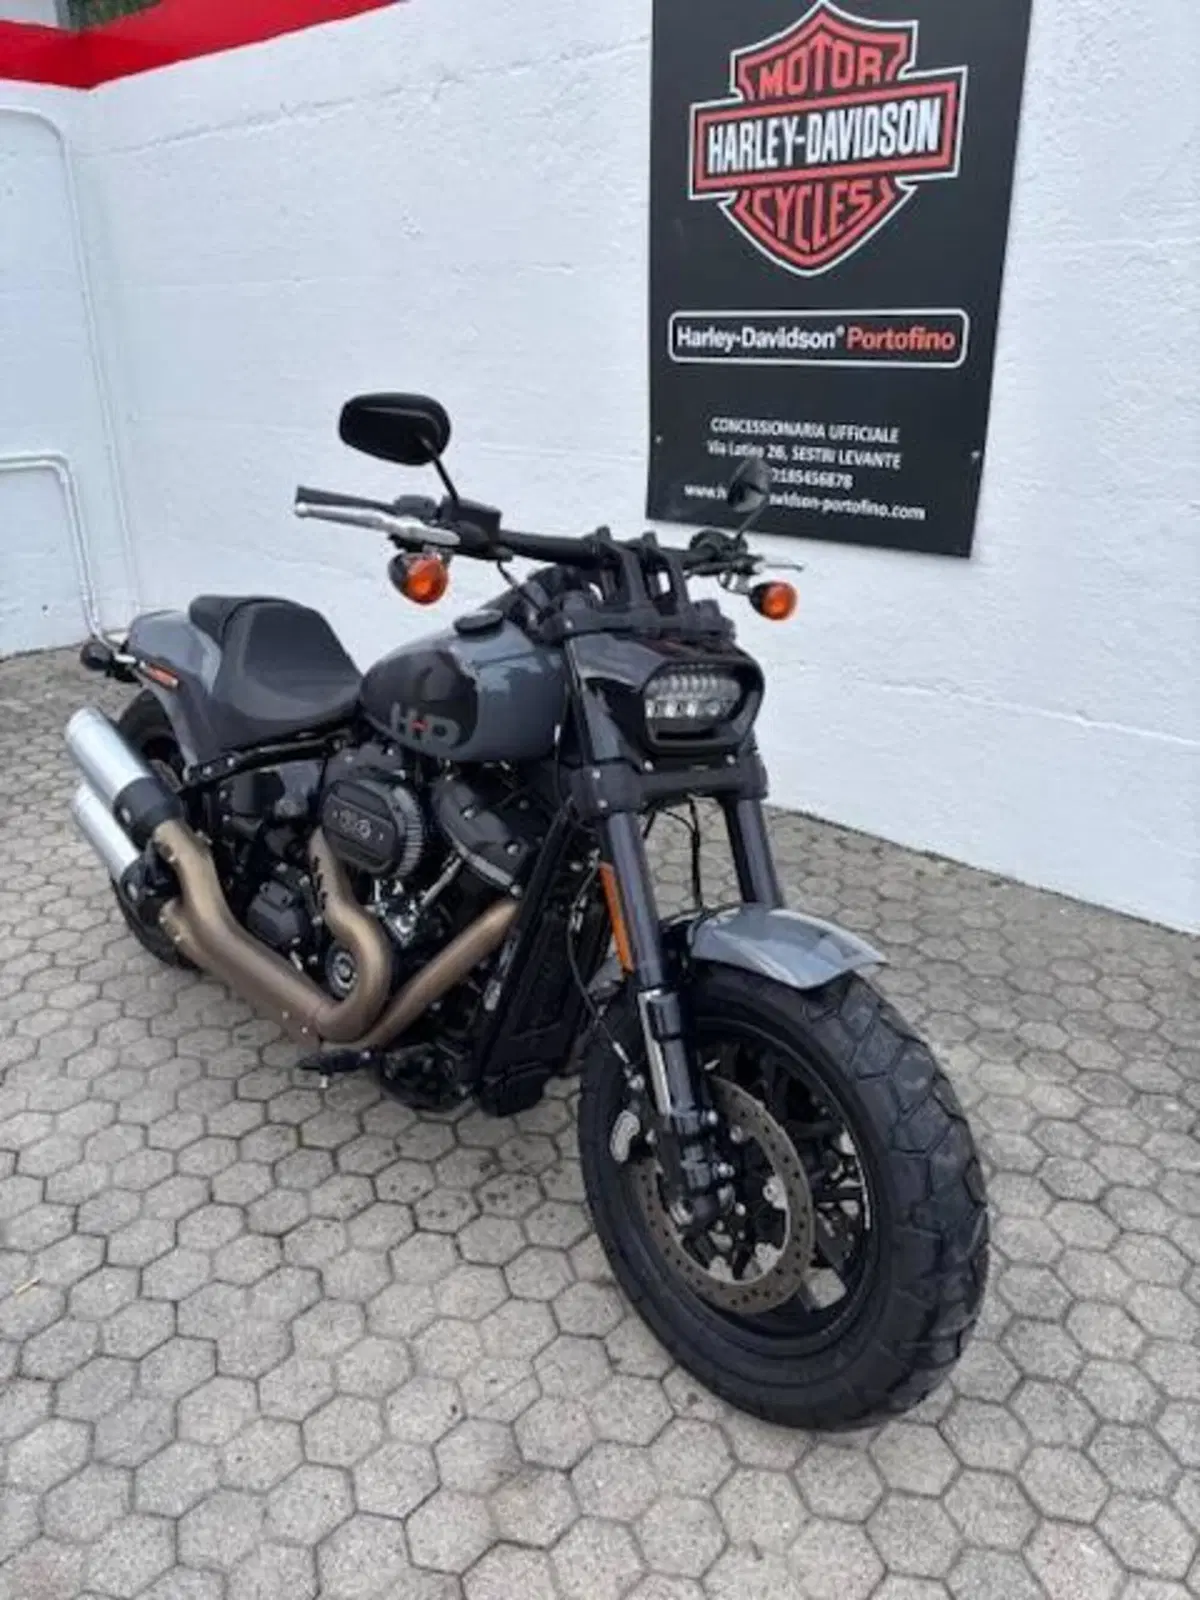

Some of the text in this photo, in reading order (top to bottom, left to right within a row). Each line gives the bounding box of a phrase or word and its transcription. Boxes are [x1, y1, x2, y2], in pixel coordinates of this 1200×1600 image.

[759, 33, 884, 98] MOTOR
[707, 98, 943, 174] HARLEY-DAVIDSON
[752, 180, 873, 252] CYCLES
[846, 325, 956, 351] Portofino
[711, 417, 900, 444] CONCESSIONARIA UFFICIALE
[838, 449, 902, 471] LEVANTE
